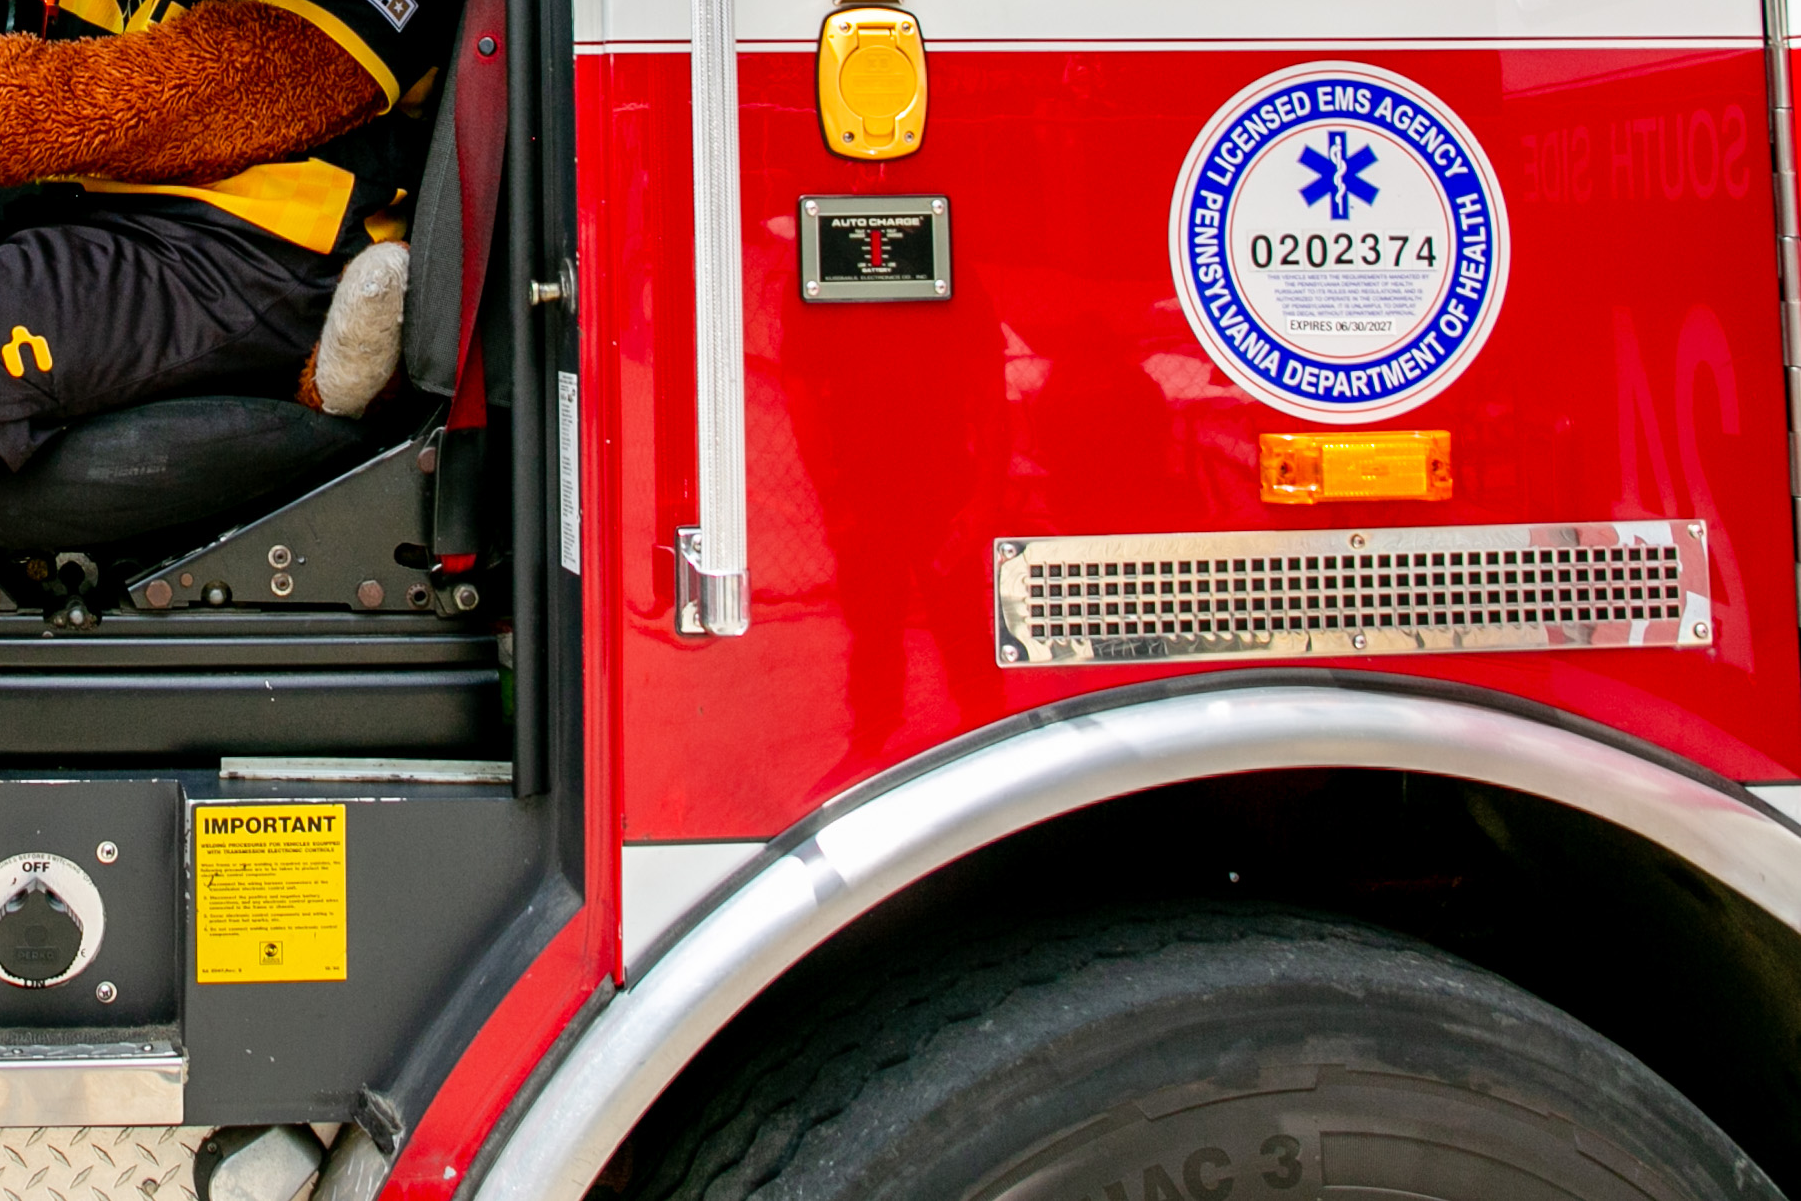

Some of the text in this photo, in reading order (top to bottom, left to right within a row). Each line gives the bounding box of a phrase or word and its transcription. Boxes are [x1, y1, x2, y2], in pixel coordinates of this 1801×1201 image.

[1207, 86, 1468, 187] LICENSED EMS AGENCY
[832, 218, 920, 227] AUTO CHARGE
[1250, 233, 1437, 269] 0202374
[1192, 189, 1488, 398] PENNSYLVANIA DEPARTMENT OF HEALTH
[1290, 320, 1392, 332] EXPIRES 06/30/2027
[204, 816, 336, 835] IMPORTANT
[22, 862, 51, 872] OFF
[1259, 1134, 1302, 1189] 3
